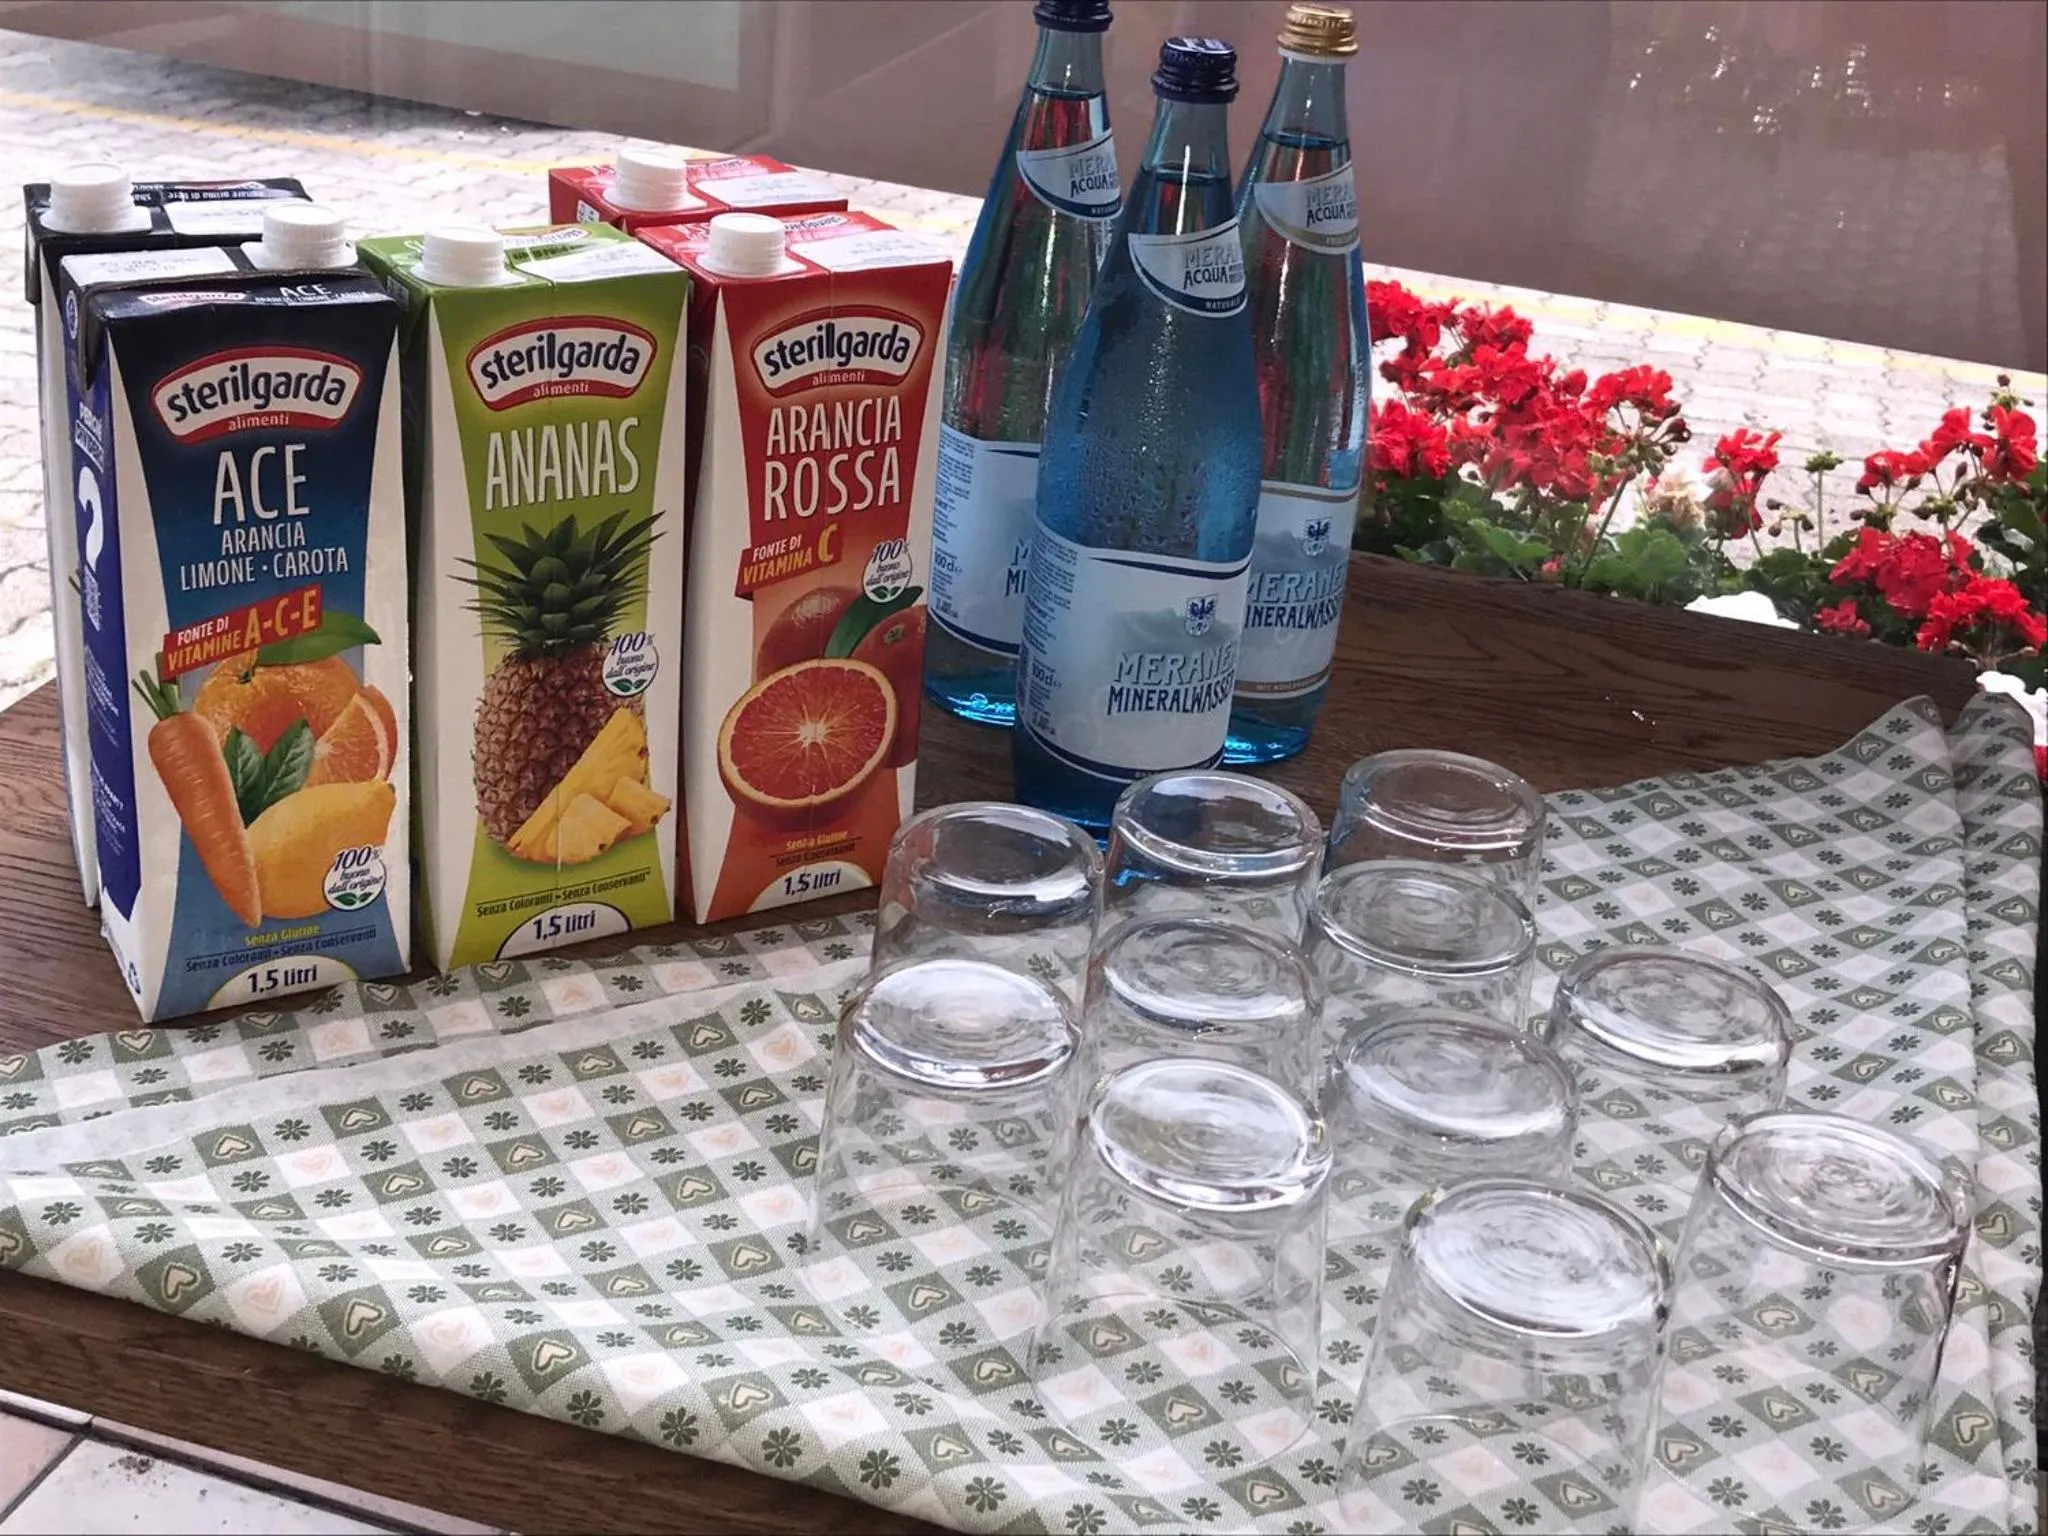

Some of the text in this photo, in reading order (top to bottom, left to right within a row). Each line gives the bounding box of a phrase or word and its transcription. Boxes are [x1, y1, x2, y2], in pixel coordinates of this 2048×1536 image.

[1070, 174, 1108, 198] ACQUA
[1306, 203, 1347, 228] ACQUA
[280, 283, 332, 298] ACE
[1184, 266, 1229, 290] ACQUA
[480, 333, 640, 389] sterilgarda
[764, 322, 910, 377] sterilgarda
[166, 362, 346, 423] sterilgarda
[533, 382, 589, 398] alimenti
[812, 371, 866, 386] alimenti
[228, 413, 289, 431] alimenti
[766, 395, 901, 456] ARANCIA
[485, 417, 640, 511] ANANAS
[213, 443, 310, 525] ACE
[764, 447, 900, 521] ROSSA
[222, 521, 306, 555] ARANCIA
[753, 534, 802, 562] FONTE DI
[181, 547, 349, 591] LIMONE CAROTA
[743, 523, 838, 585] VITAMINA C
[178, 616, 229, 646] FONTE DI
[168, 630, 241, 671] VITAMINE
[784, 868, 842, 895] 1,5 litri
[476, 904, 507, 918] Senza
[562, 886, 591, 900] Senza
[245, 932, 278, 946] Senza
[533, 910, 596, 941] 1,5 litri
[186, 958, 219, 973] Senza
[281, 941, 313, 957] Senza
[284, 964, 318, 987] litri
